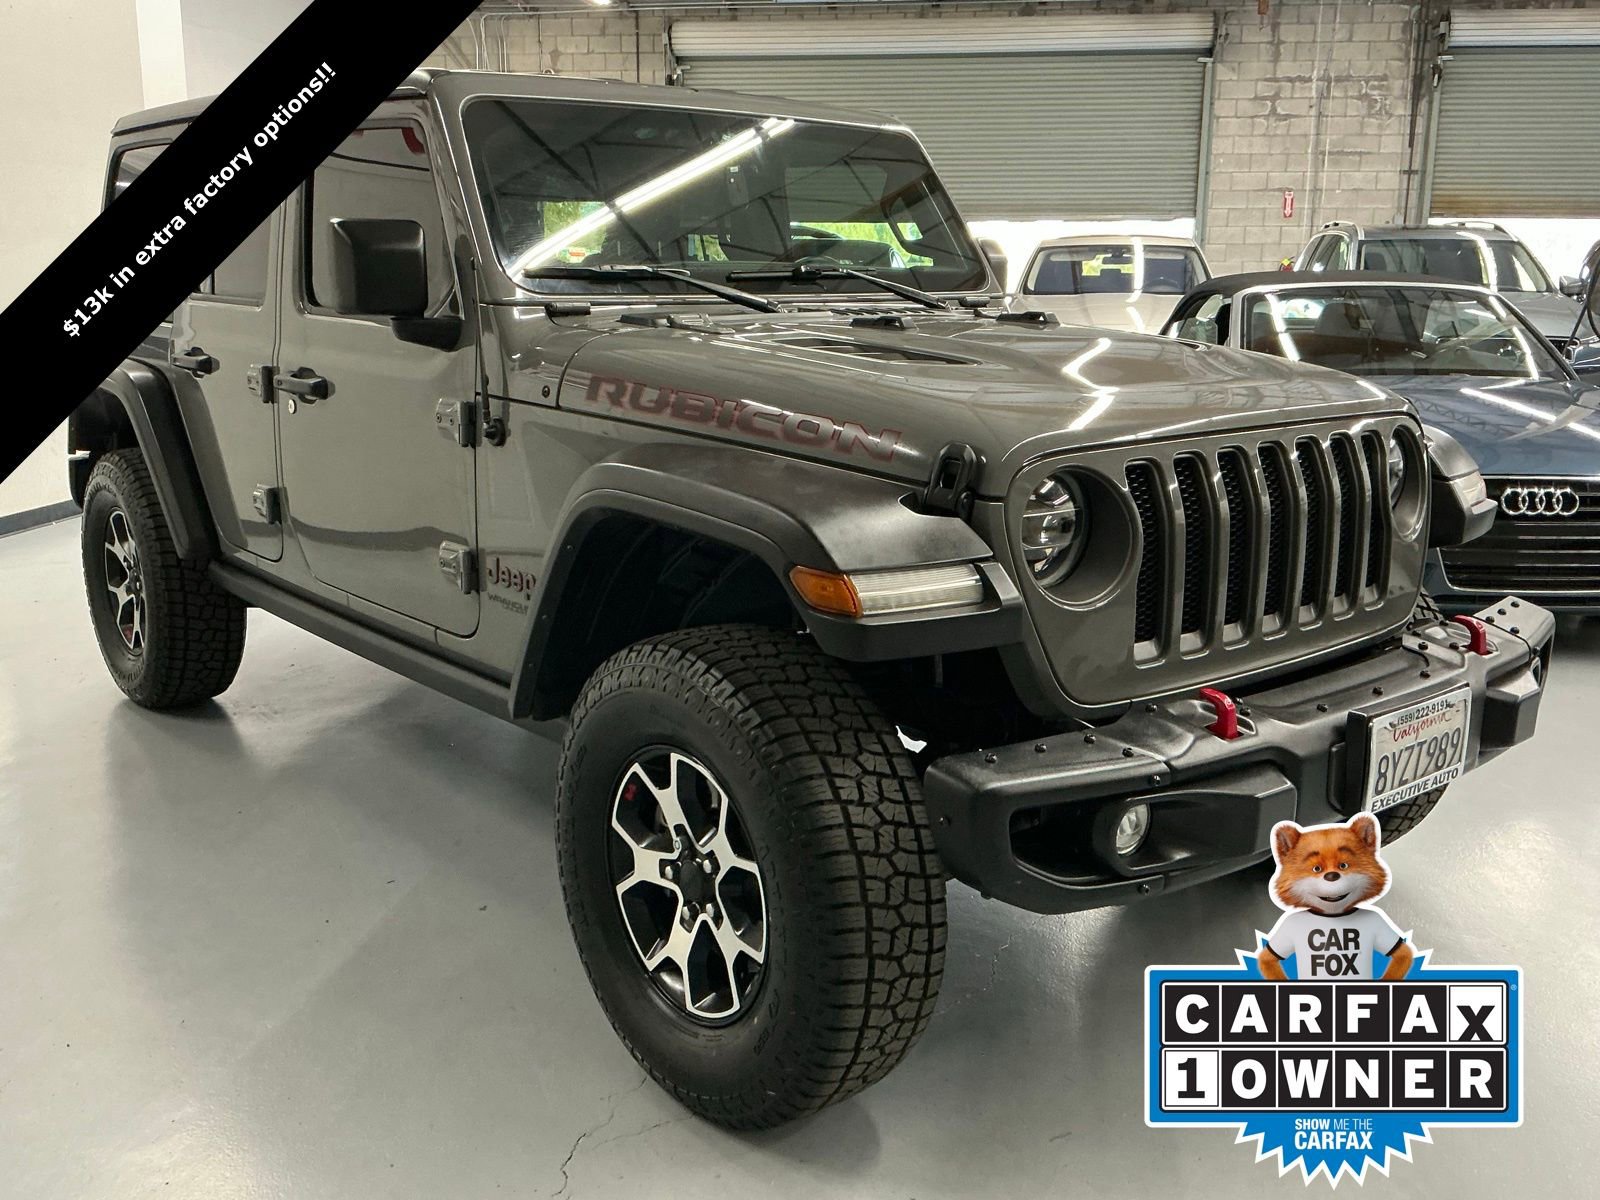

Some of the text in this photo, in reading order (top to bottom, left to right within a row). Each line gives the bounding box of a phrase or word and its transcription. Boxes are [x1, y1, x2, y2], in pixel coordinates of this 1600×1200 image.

[585, 375, 902, 463] RUBICON
[487, 557, 536, 600] Jeep
[1393, 712, 1452, 742] California
[1375, 727, 1461, 797] 8YZT989
[1371, 767, 1459, 812] EXECUTIVE AUTO
